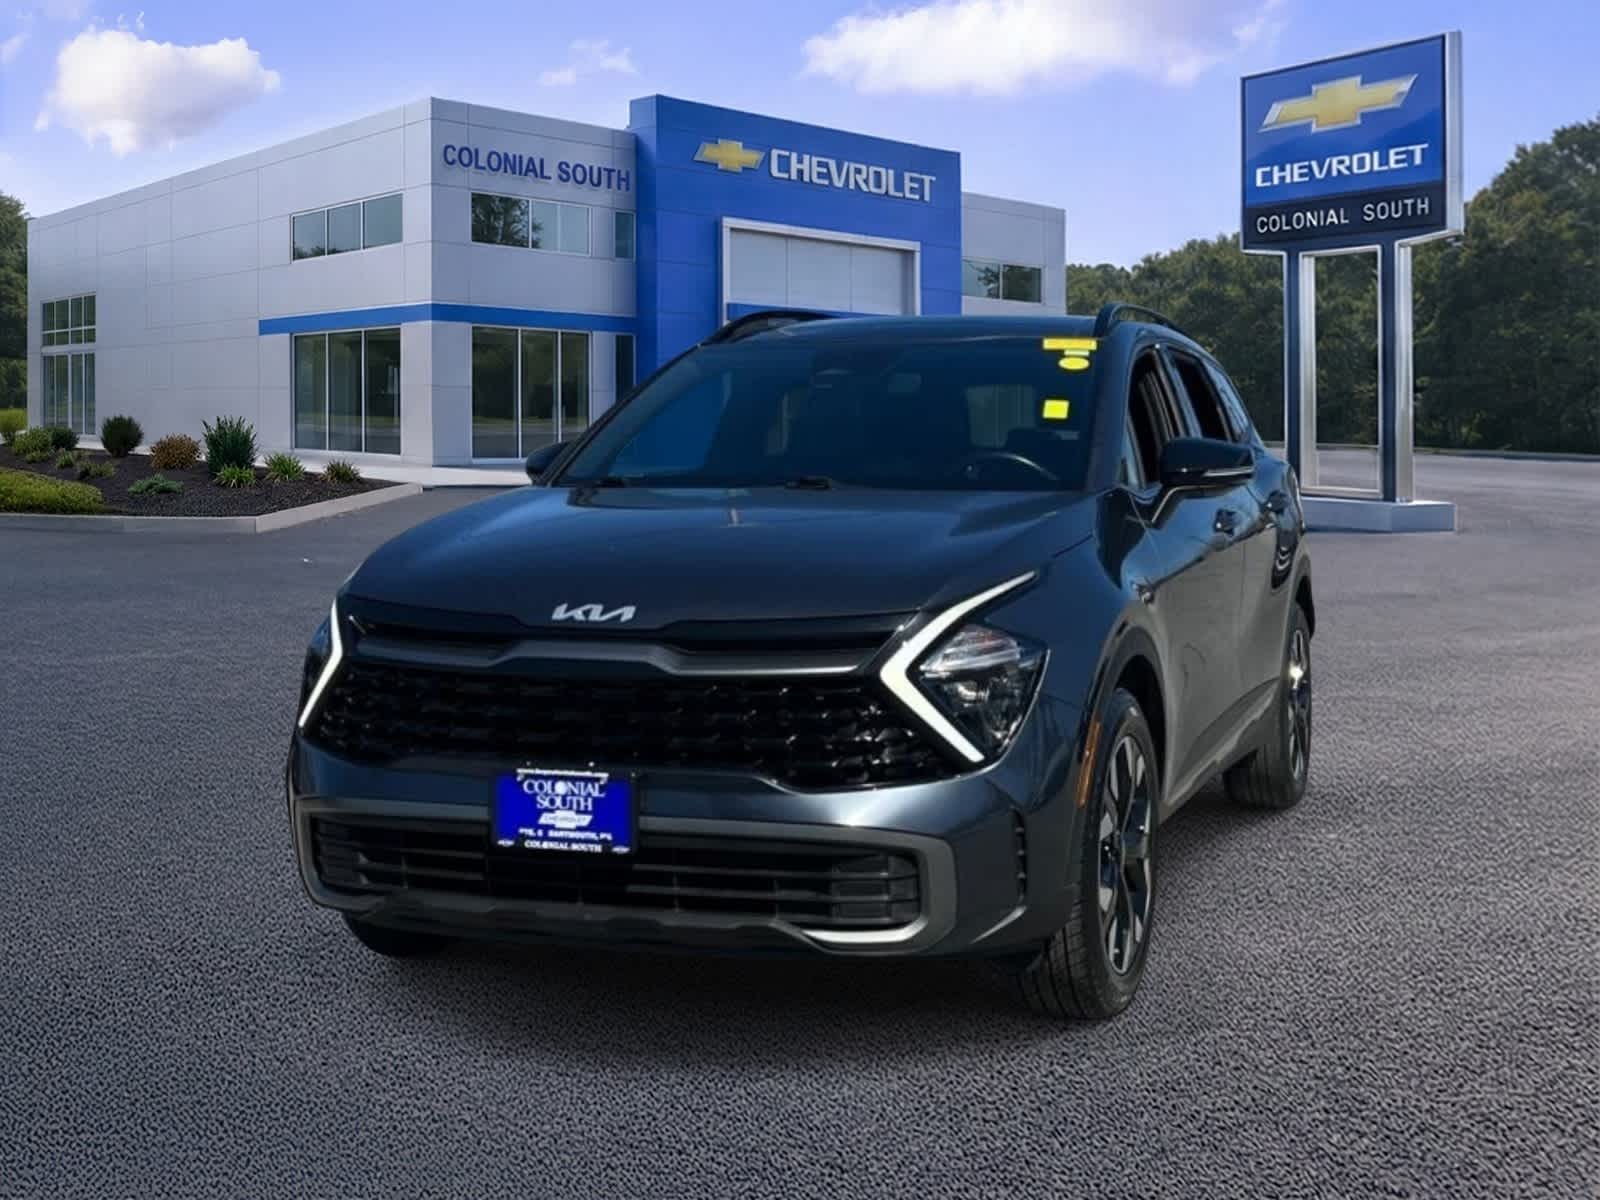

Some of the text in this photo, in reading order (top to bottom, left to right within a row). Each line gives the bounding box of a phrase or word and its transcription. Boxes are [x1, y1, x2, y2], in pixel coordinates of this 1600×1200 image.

[443, 144, 631, 192] COLONIAL SOUTH
[769, 148, 937, 203] CHEVROLET
[1255, 143, 1429, 188] CHEVROLET
[1256, 196, 1430, 234] COLONIAL SOUTH
[523, 779, 606, 798] COLONIAL
[536, 795, 593, 811] SOUTH
